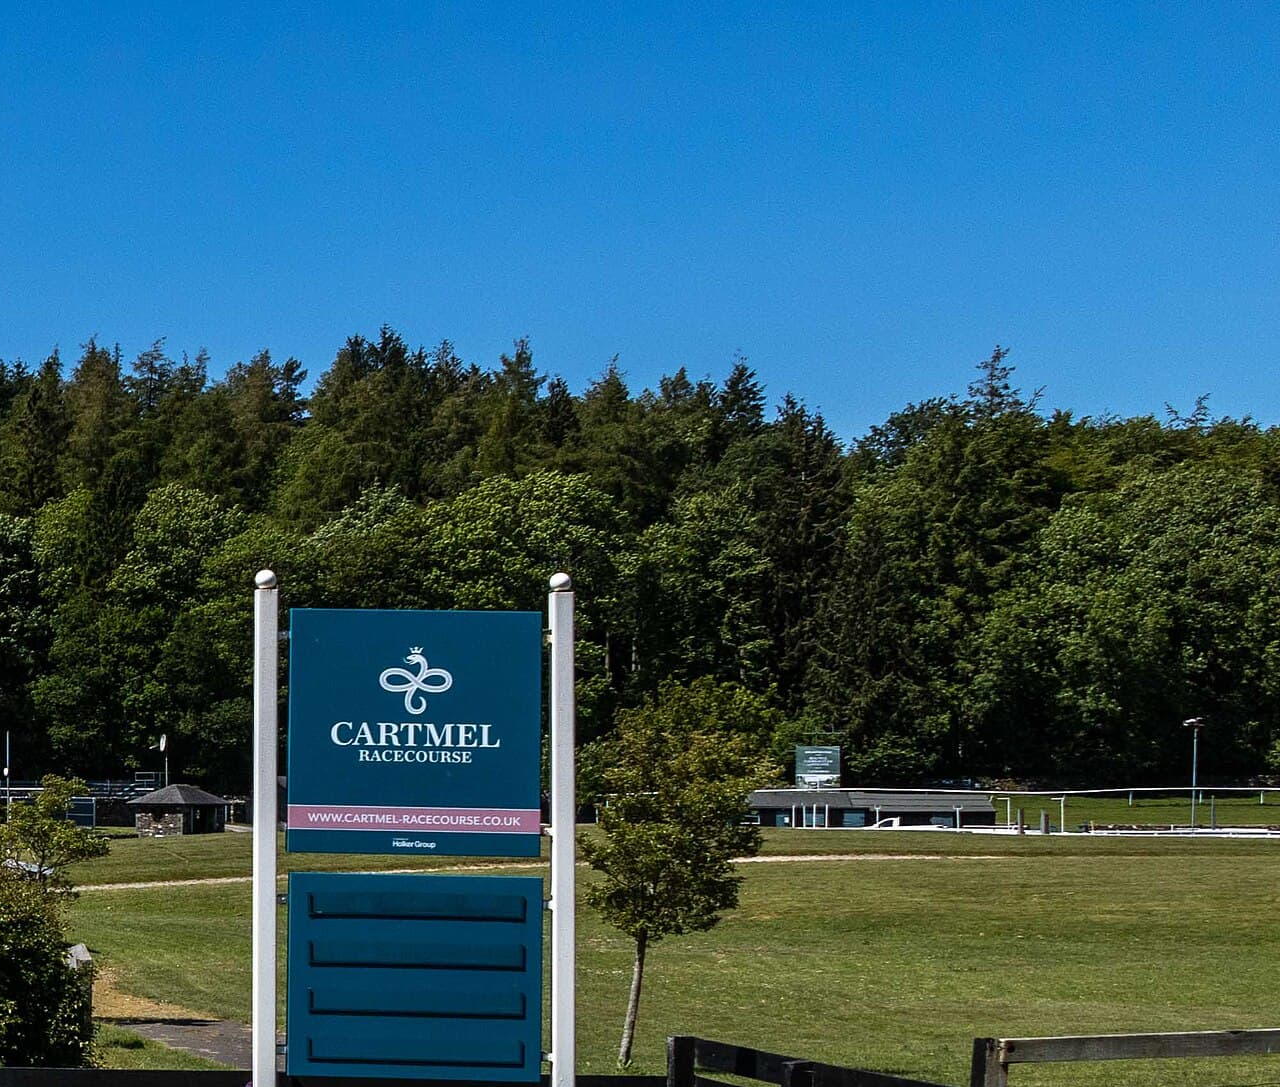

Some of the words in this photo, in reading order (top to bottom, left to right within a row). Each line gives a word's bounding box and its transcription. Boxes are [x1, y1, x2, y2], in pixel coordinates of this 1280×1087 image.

[330, 721, 501, 748] CARTMEL
[358, 749, 473, 763] RACECOURSE
[307, 812, 521, 827] WWW.CARTMEL-RACECOURSE.CO.UK
[414, 840, 437, 849] Group
